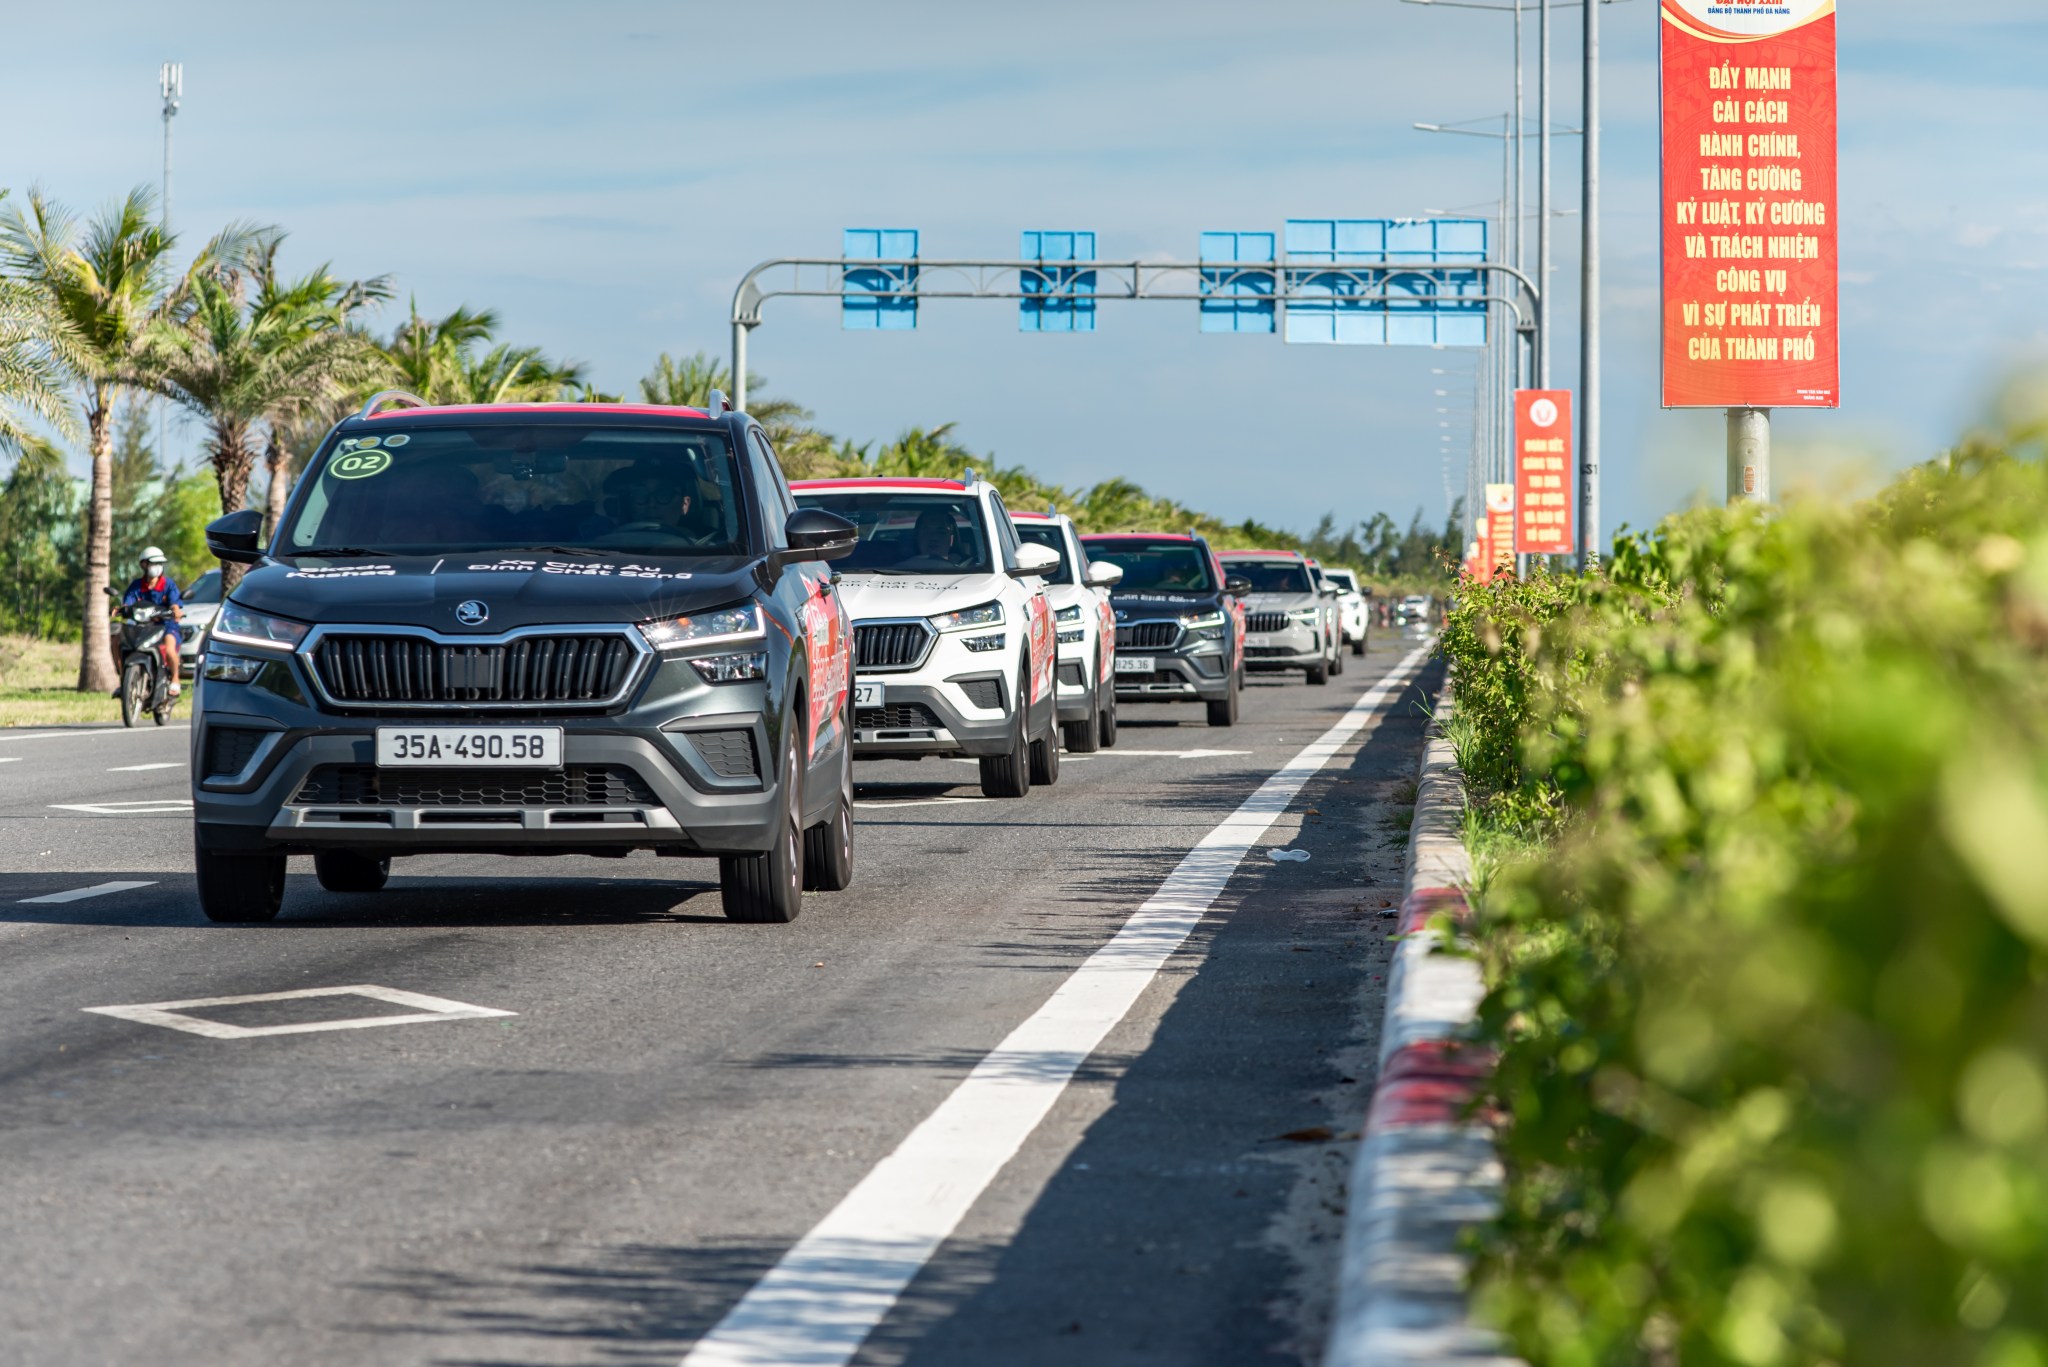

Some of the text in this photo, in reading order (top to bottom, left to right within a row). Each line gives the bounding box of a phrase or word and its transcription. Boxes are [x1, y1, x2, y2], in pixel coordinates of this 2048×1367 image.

[1733, 6, 1752, 14] THÀNH
[1709, 59, 1791, 94] ĐẨY MẠNH
[1713, 95, 1788, 123] CẢI CÁCH
[1700, 131, 1801, 159] HÀNH CHÍNH,
[1700, 164, 1802, 191] TĂNG CƯỜNG
[1676, 196, 1826, 228] KỶ LUẬT, KỶ CƯƠNG
[1684, 232, 1818, 263] VÀ TRÁCH NHIỆM
[1716, 266, 1787, 297] CÔNG VỤ
[1683, 296, 1821, 330] VÌ SỰ PHÁT TRIỂN
[1688, 331, 1815, 361] CỦA THÀNH PHỐ
[341, 456, 381, 471] 02
[393, 735, 545, 760] 35A-490.58
